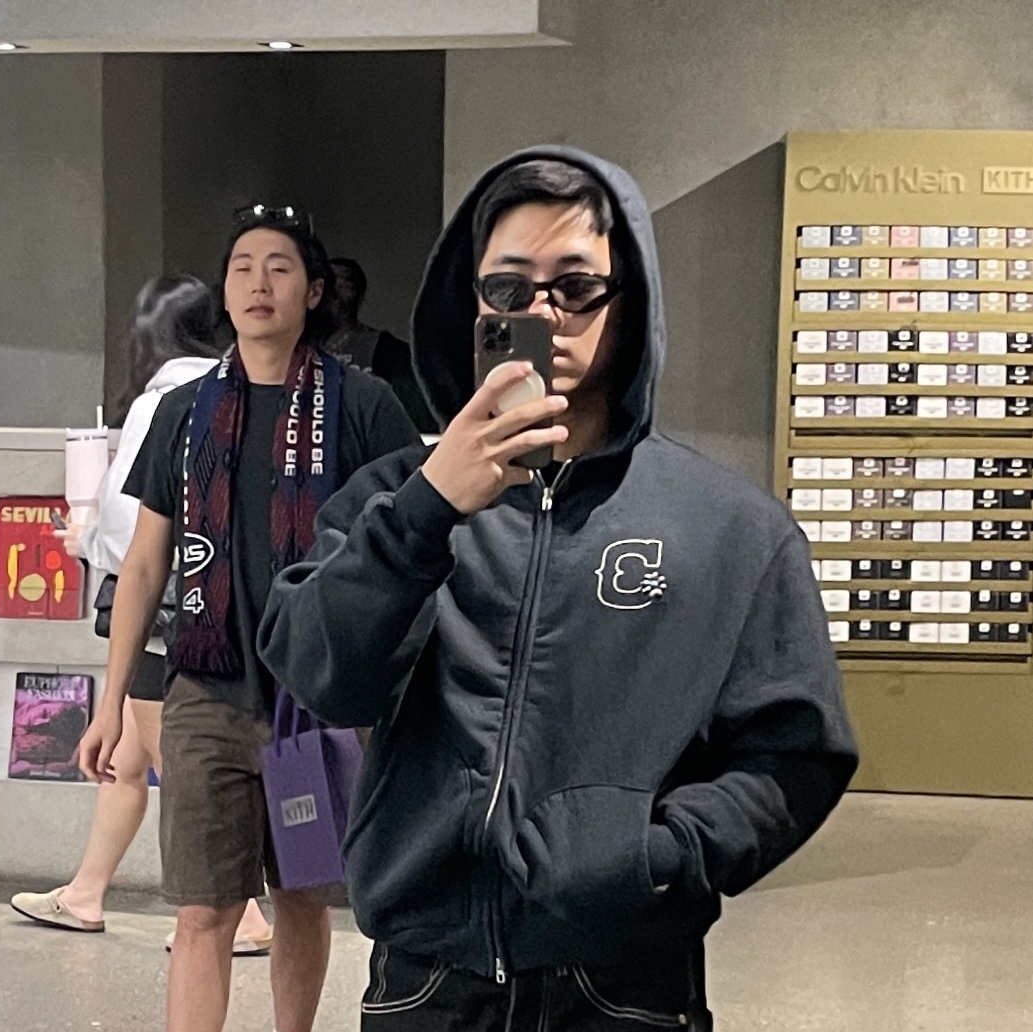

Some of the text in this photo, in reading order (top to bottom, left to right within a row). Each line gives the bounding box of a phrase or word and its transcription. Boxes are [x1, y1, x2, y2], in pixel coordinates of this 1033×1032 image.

[795, 165, 965, 195] Calvin Klein
[312, 368, 325, 444] SHOULD
[284, 448, 297, 477] BE
[311, 448, 323, 475] BE
